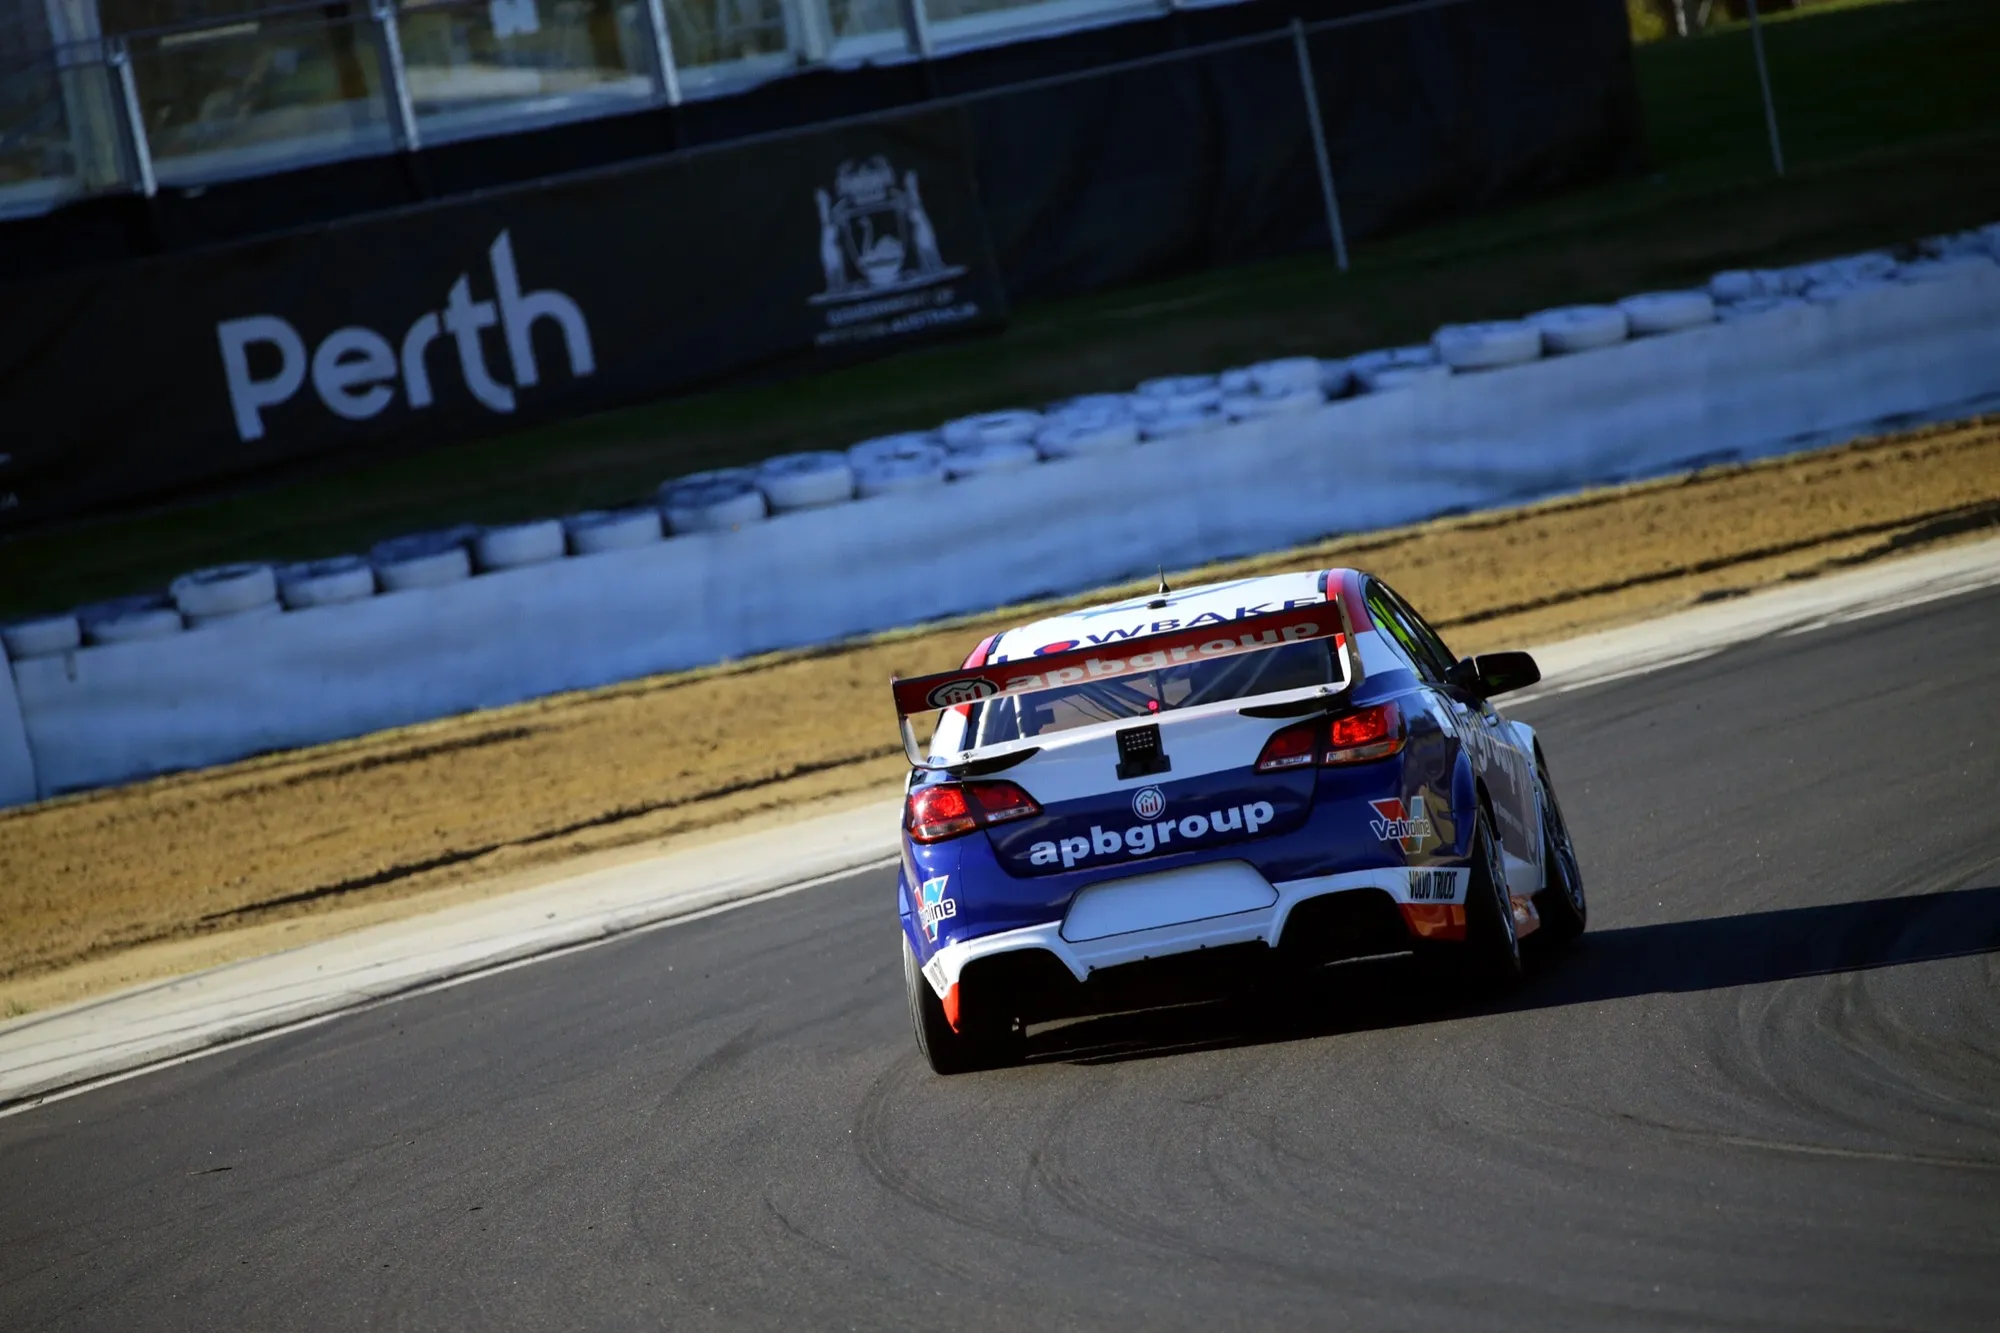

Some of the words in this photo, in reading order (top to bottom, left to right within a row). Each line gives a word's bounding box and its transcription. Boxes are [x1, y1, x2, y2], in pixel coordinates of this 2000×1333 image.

[216, 229, 596, 442] Perth
[1006, 622, 1320, 692] apbgroup
[1029, 800, 1275, 868] apbgroup
[1369, 816, 1431, 841] Valvoline
[1408, 870, 1432, 899] VOLVO
